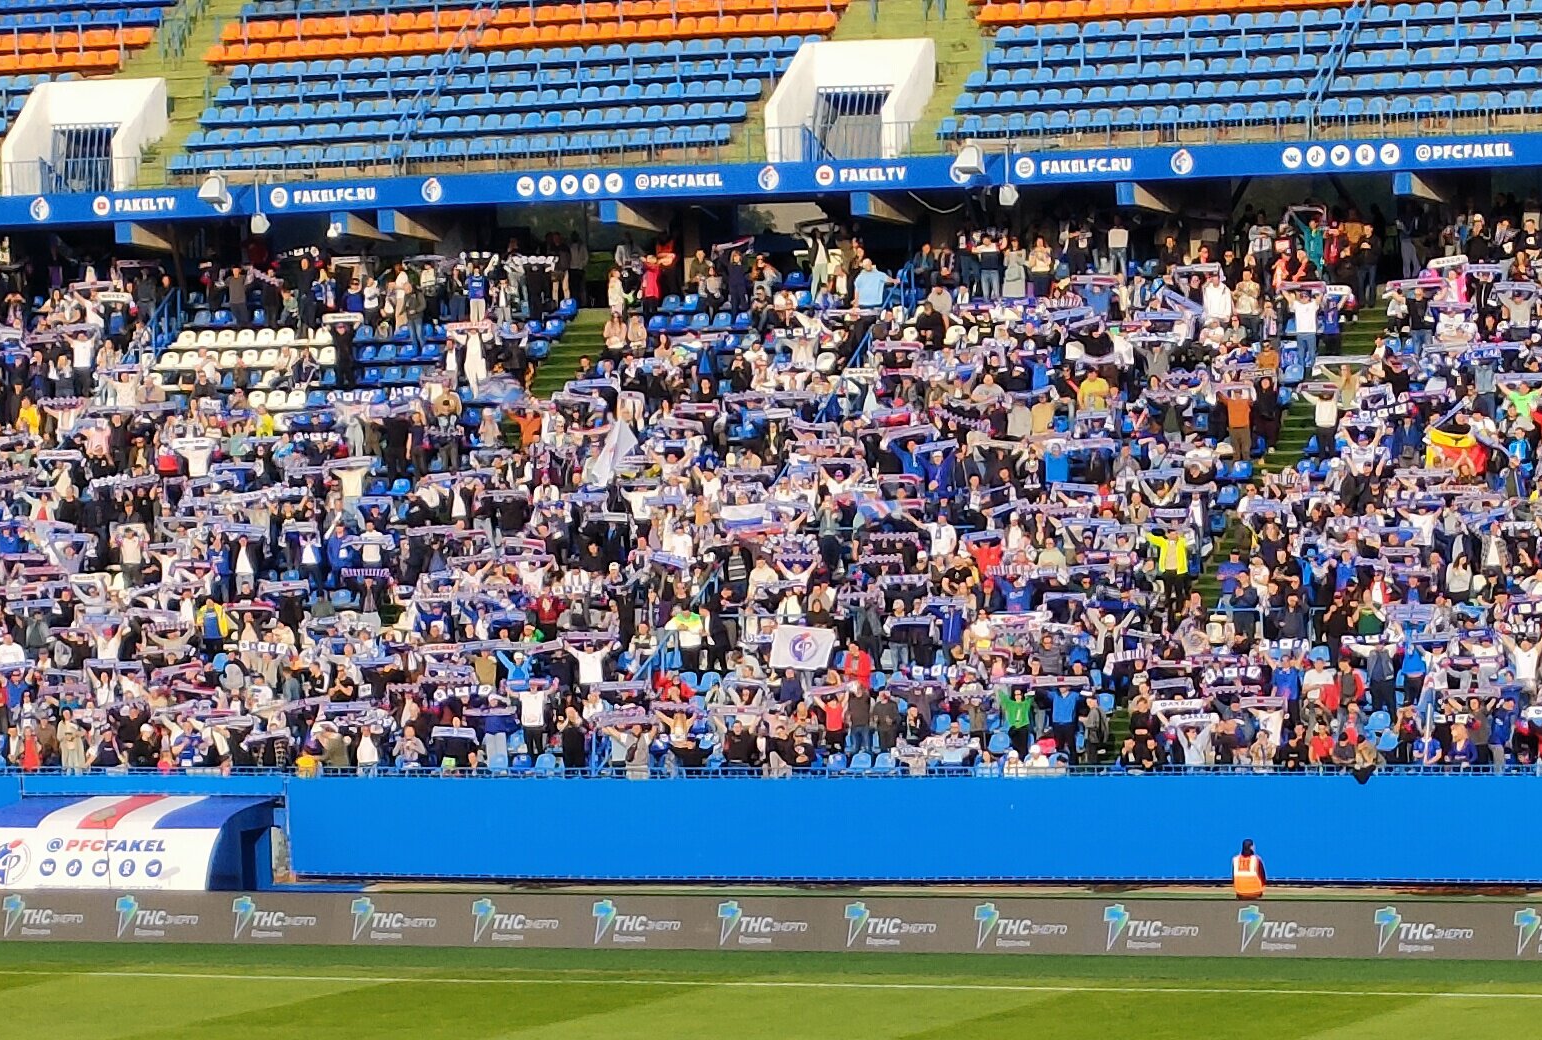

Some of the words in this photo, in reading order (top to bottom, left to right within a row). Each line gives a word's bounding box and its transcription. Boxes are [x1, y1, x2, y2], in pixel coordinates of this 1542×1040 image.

[1416, 143, 1513, 161] @PFCFAKEL
[1041, 158, 1131, 174] FAKELFC.RU
[636, 174, 722, 190] @PFCFAKEL
[840, 167, 906, 182] FAKELTV
[294, 188, 375, 203] FAKELFC.RU
[115, 196, 176, 212] FAKELTV
[47, 838, 165, 852] @PFCFAKEL
